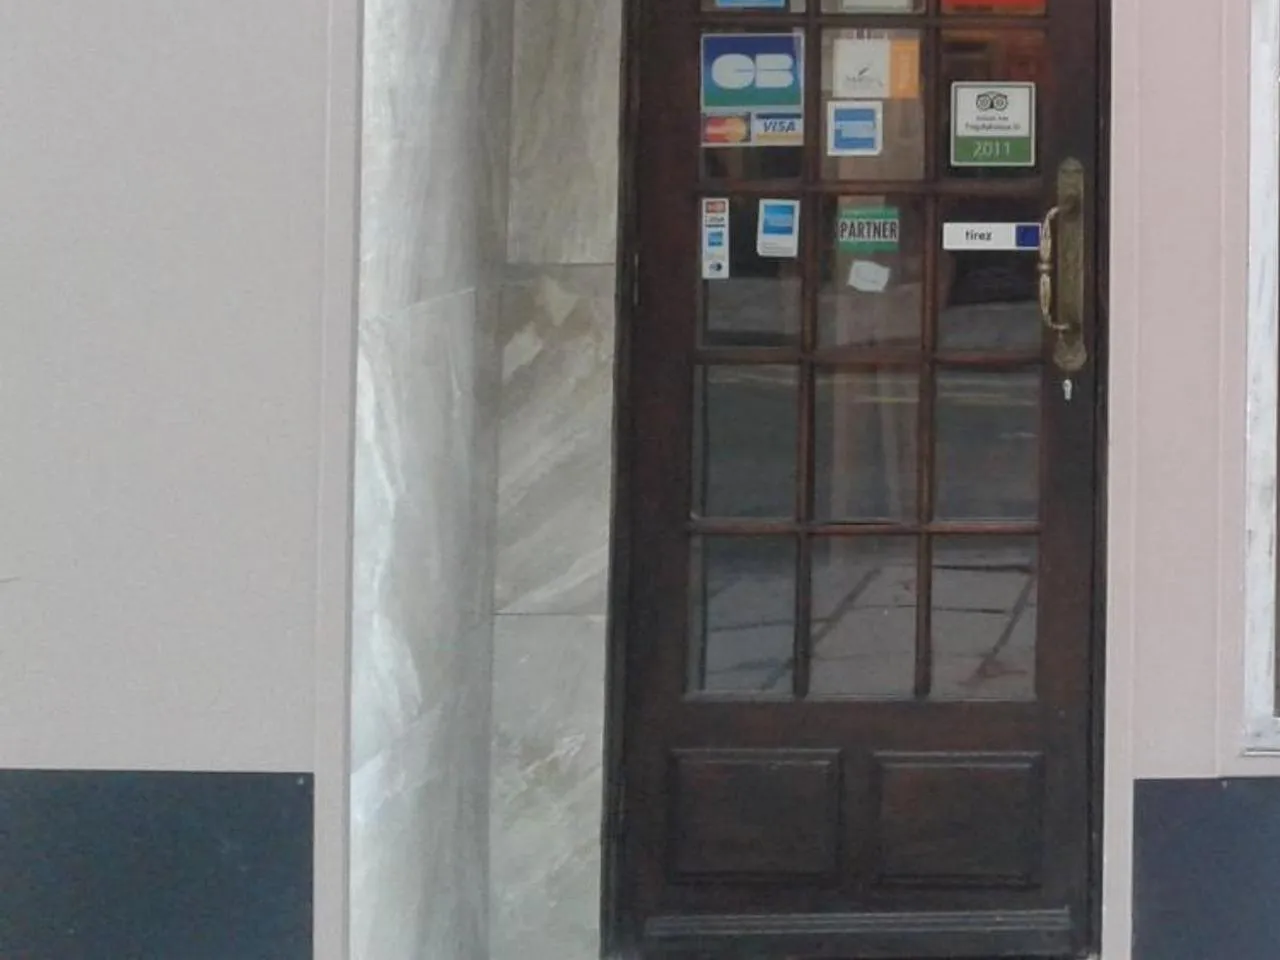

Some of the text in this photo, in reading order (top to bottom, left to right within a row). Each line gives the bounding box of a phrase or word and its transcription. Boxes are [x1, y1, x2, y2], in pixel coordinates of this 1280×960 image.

[711, 52, 794, 89] CB
[762, 120, 797, 133] VISA
[973, 140, 1011, 159] 2011
[839, 220, 898, 240] PARTNER
[964, 228, 993, 241] tirez
